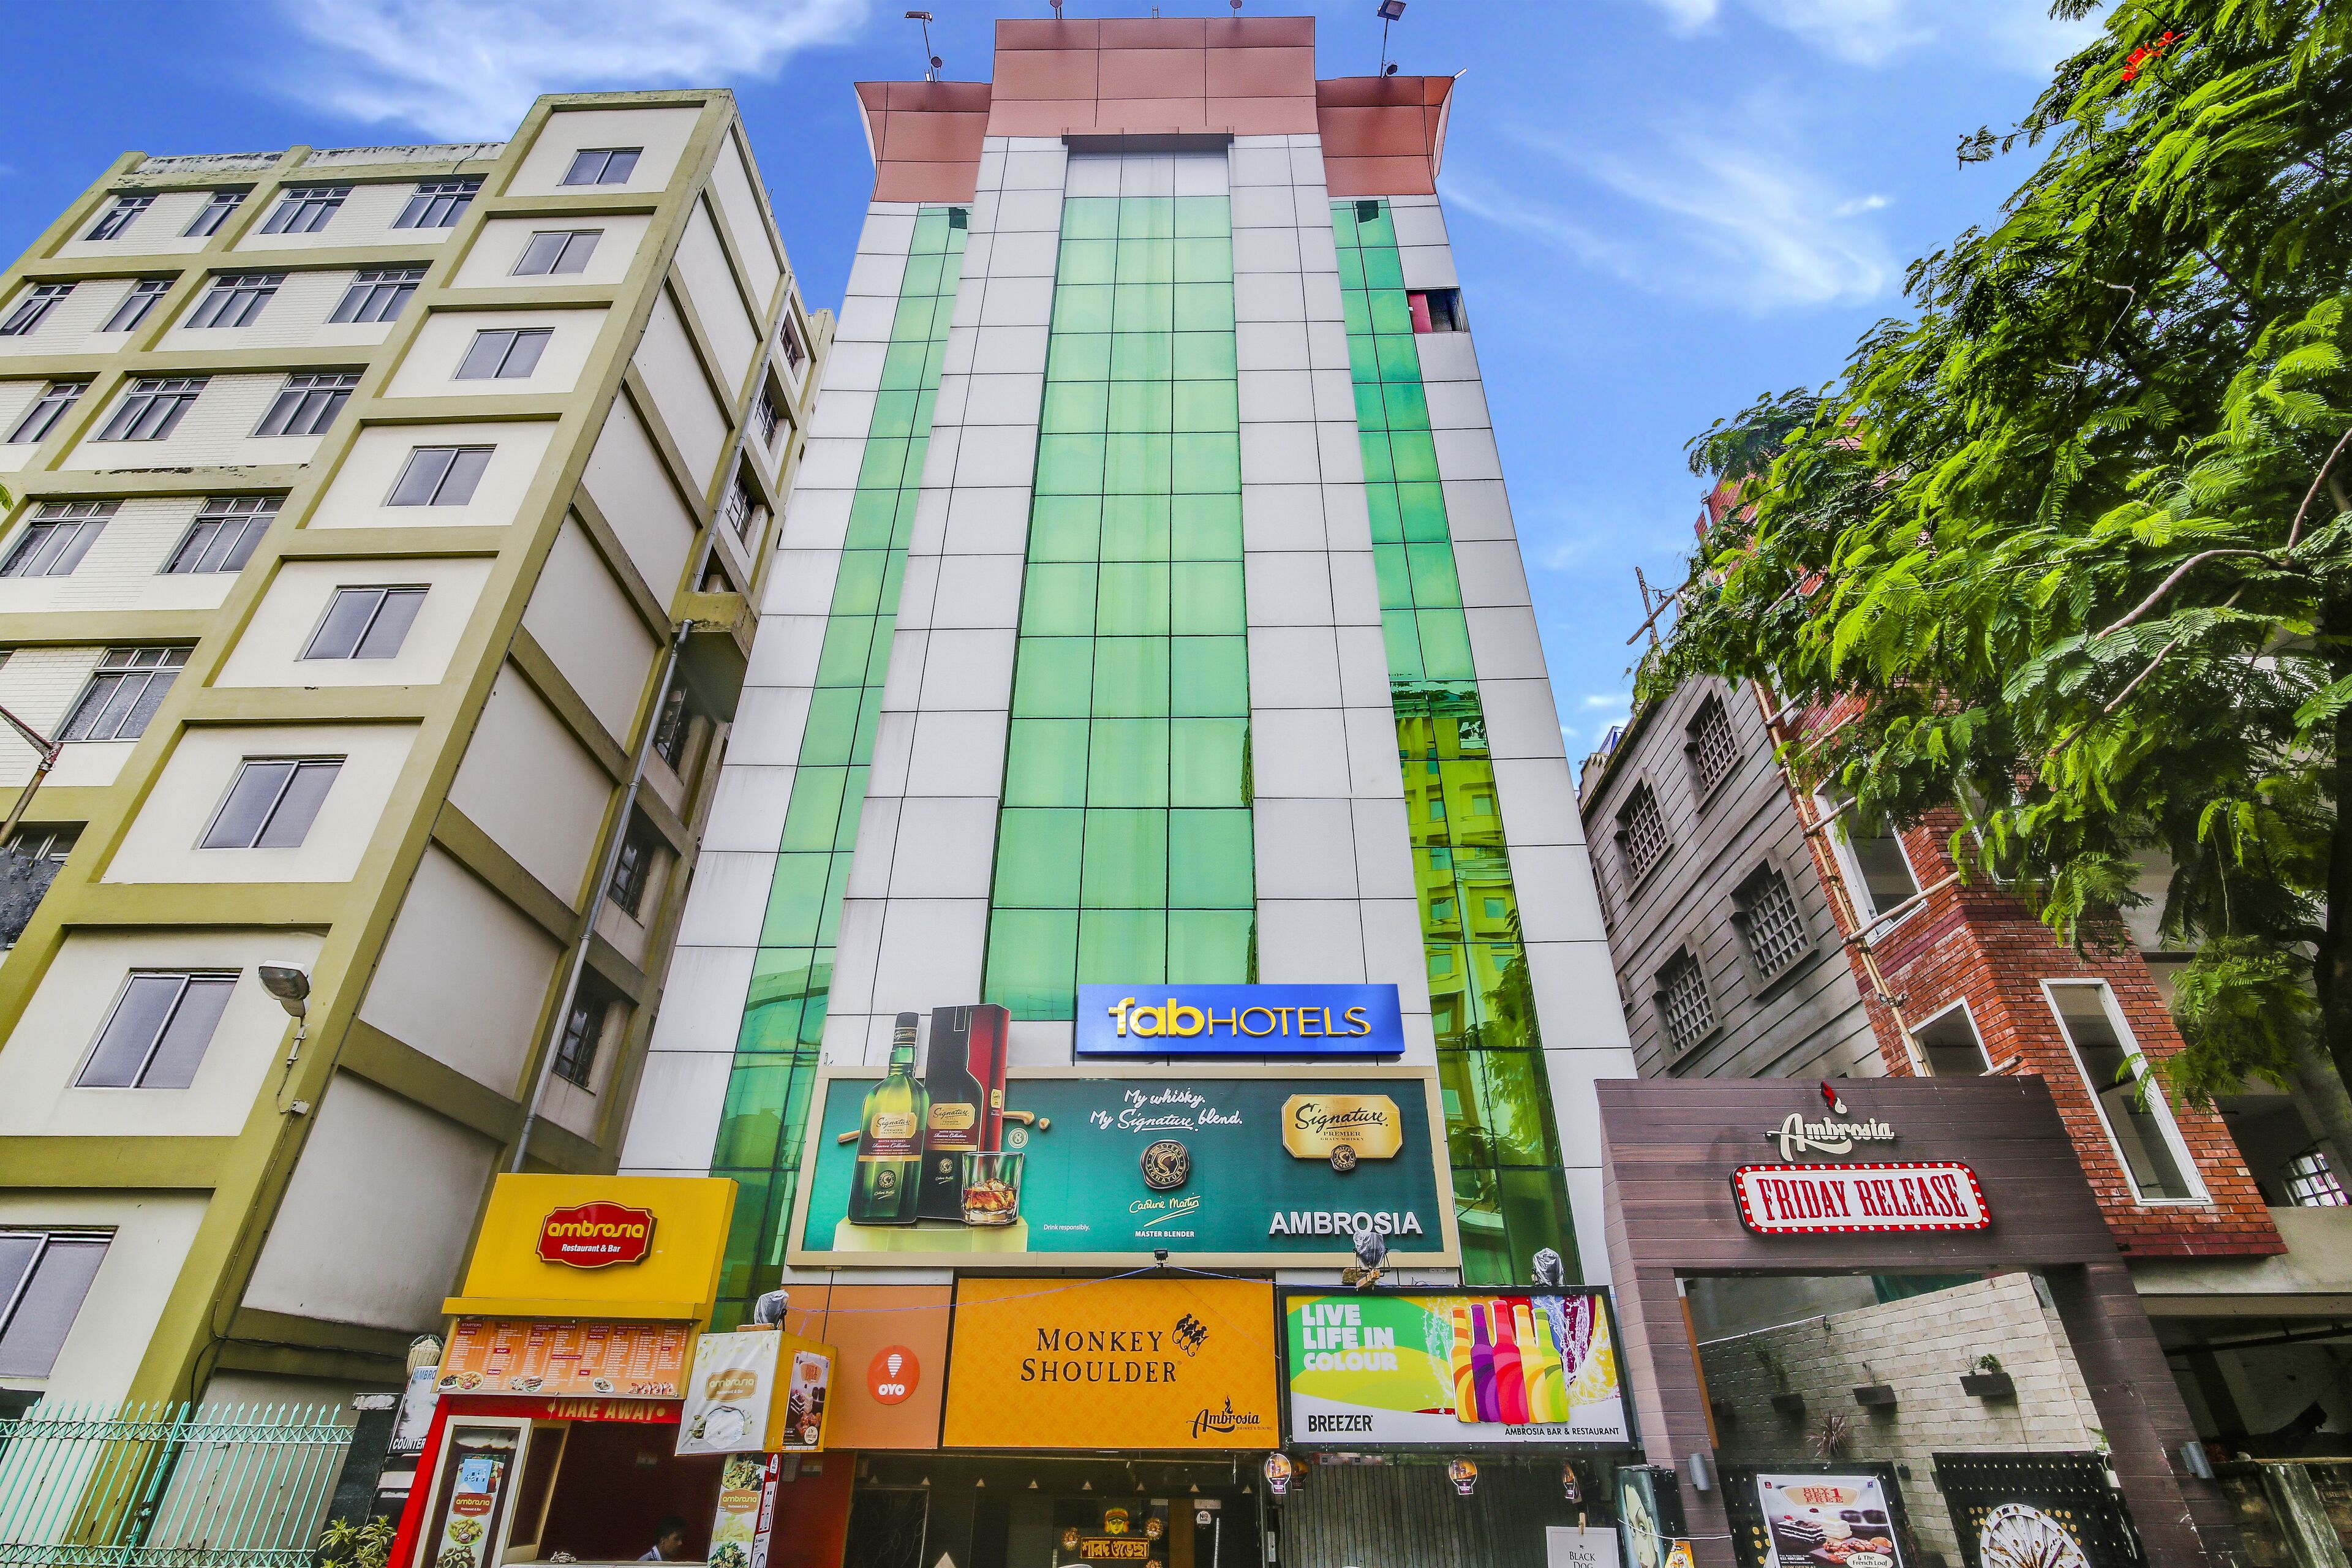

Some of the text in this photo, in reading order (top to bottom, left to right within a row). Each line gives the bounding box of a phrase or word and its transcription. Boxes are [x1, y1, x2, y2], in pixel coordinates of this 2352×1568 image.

[1108, 997, 1372, 1038] fabHOTELS
[1124, 1087, 1206, 1108] My whisky.
[1090, 1110, 1114, 1129] My
[1198, 1107, 1243, 1125] blend.
[1765, 1113, 1895, 1161] Ambrosia
[1147, 1164, 1183, 1182] SIGNATURE
[1756, 1174, 1969, 1221] FRIDAY RELEASE
[548, 1220, 644, 1238] ambrosia
[1268, 1211, 1423, 1235] AMBROSIA
[1302, 1304, 1362, 1326] LIVE
[1036, 1328, 1163, 1351] MONKEY
[1303, 1327, 1395, 1350] LIFE IN
[1020, 1358, 1177, 1382] SHOULDER
[1303, 1352, 1398, 1371] COLOUR
[709, 1378, 755, 1388] ambrosia
[878, 1384, 905, 1396] OYO
[558, 1401, 657, 1420] TAKE AWAY
[1186, 1409, 1261, 1439] Ambrosia
[1308, 1414, 1373, 1432] BREEZER
[1830, 1488, 1843, 1498] 1
[1569, 1551, 1596, 1561] BLACK
